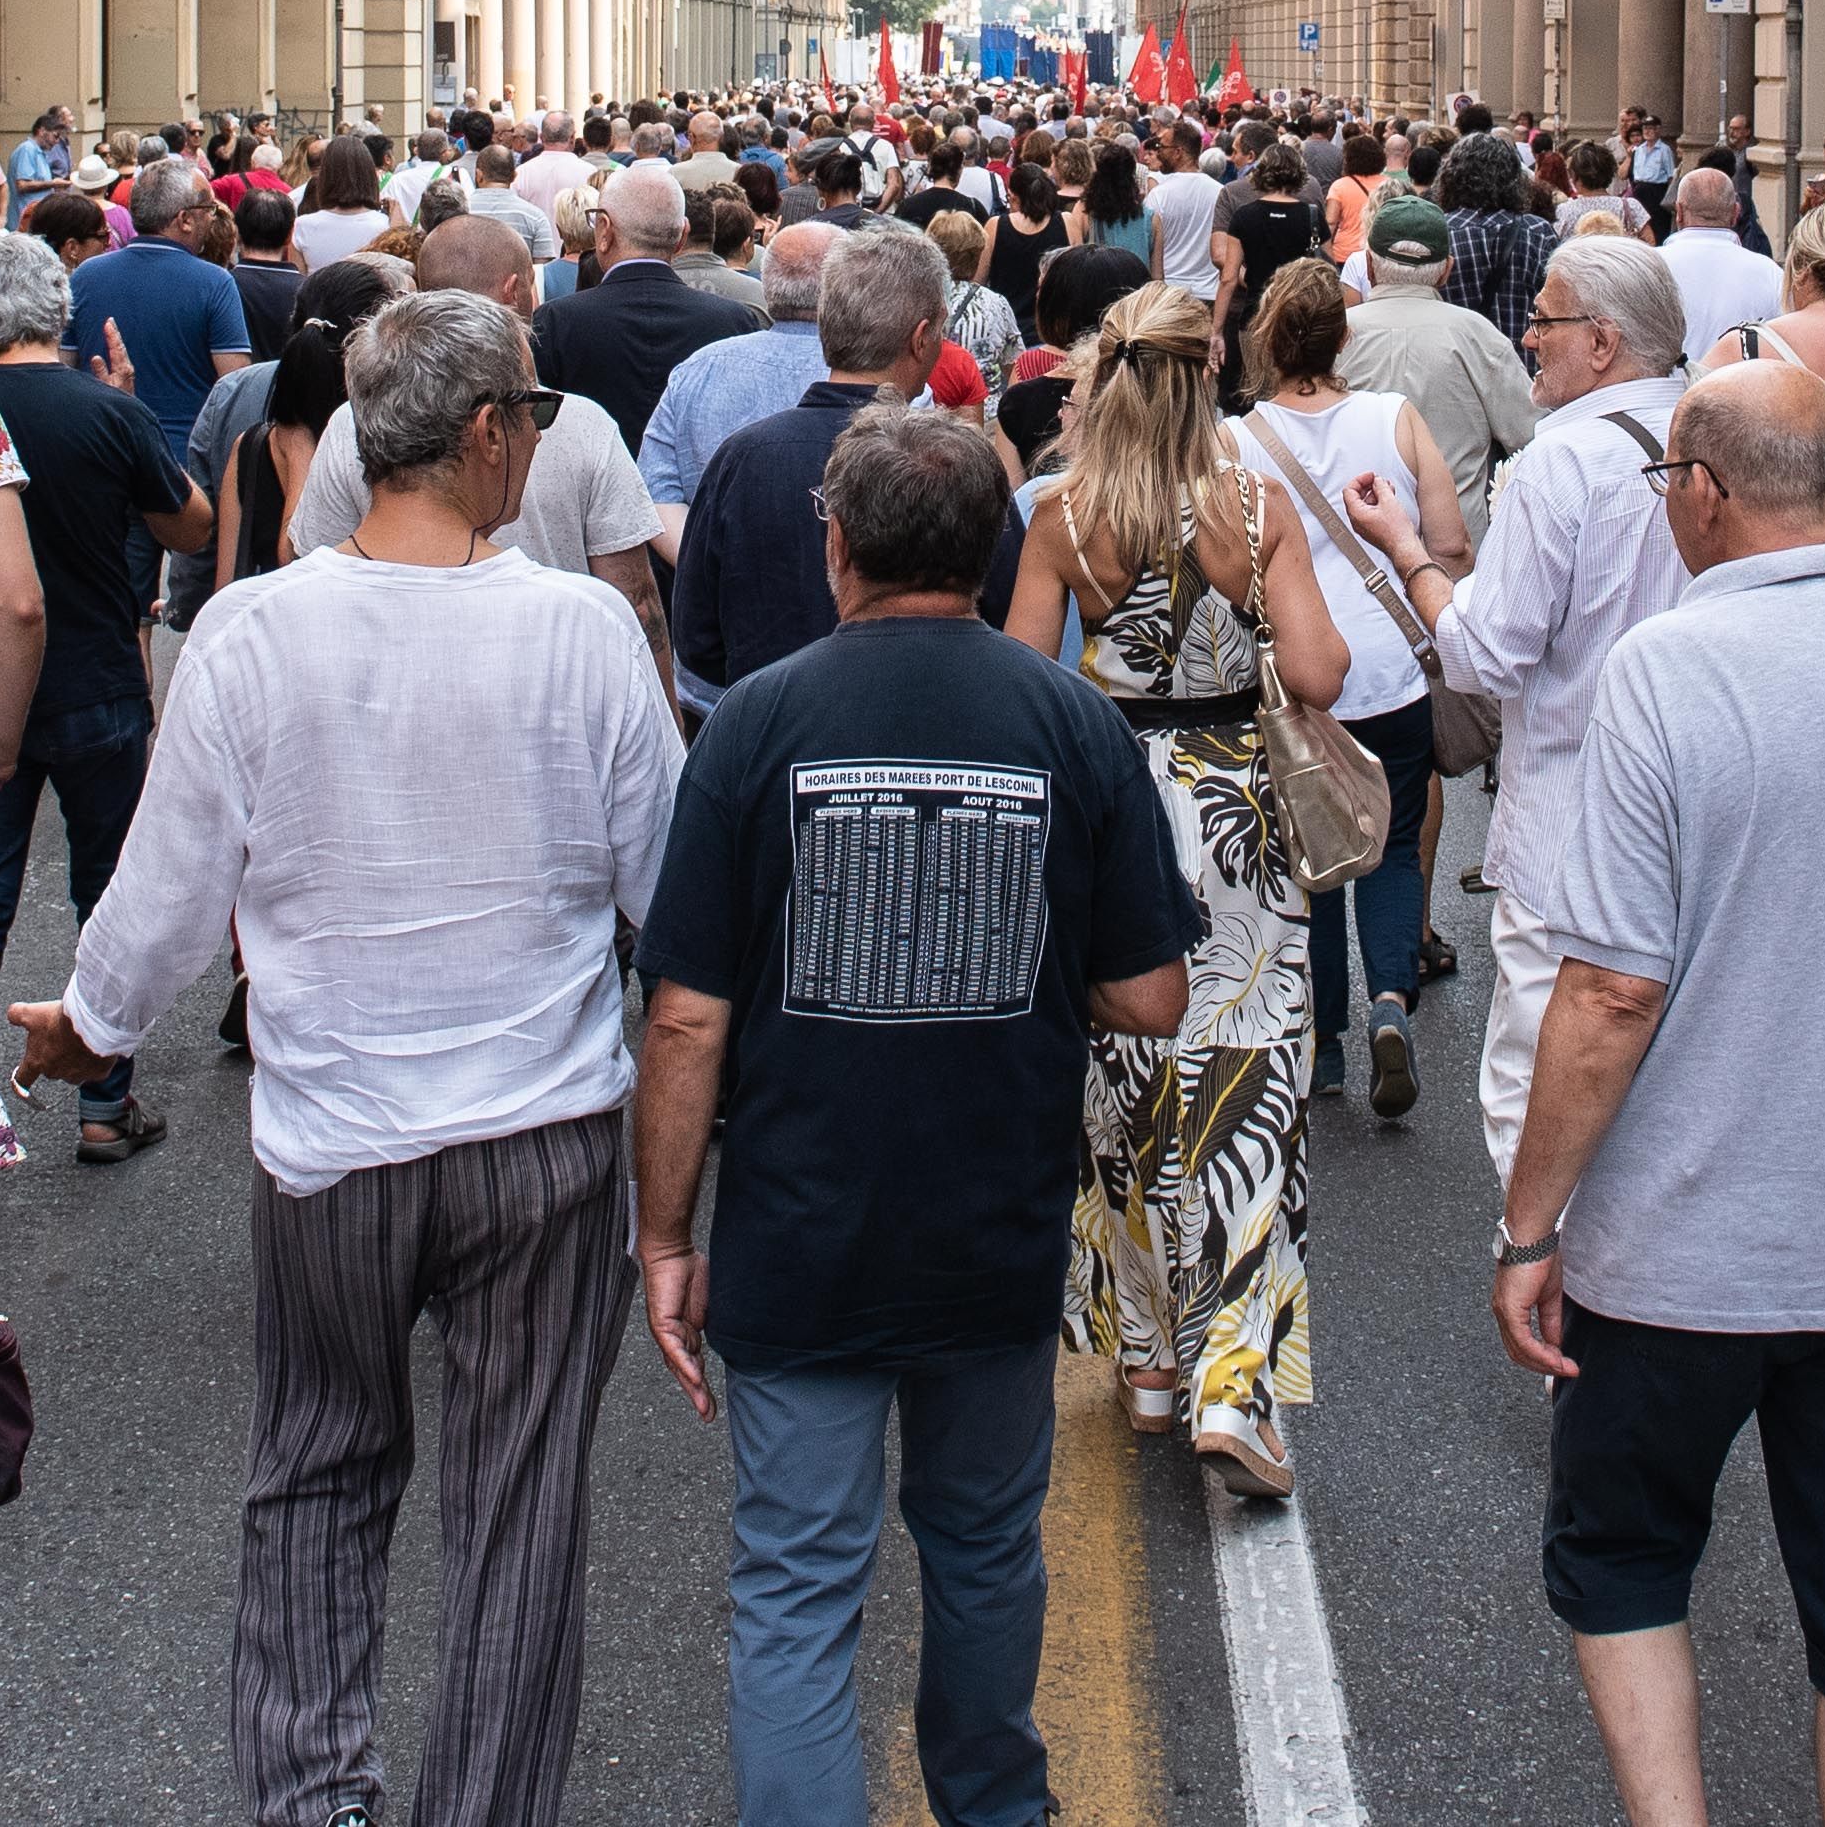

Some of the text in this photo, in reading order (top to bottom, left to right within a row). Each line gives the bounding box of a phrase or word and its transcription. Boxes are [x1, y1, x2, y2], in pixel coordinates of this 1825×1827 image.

[1303, 24, 1316, 40] P
[805, 771, 1038, 794] HORAIRES DES MAREES PORT DE LESCONIL
[828, 793, 903, 804] JUILLET 2016
[962, 795, 994, 807] AOUT
